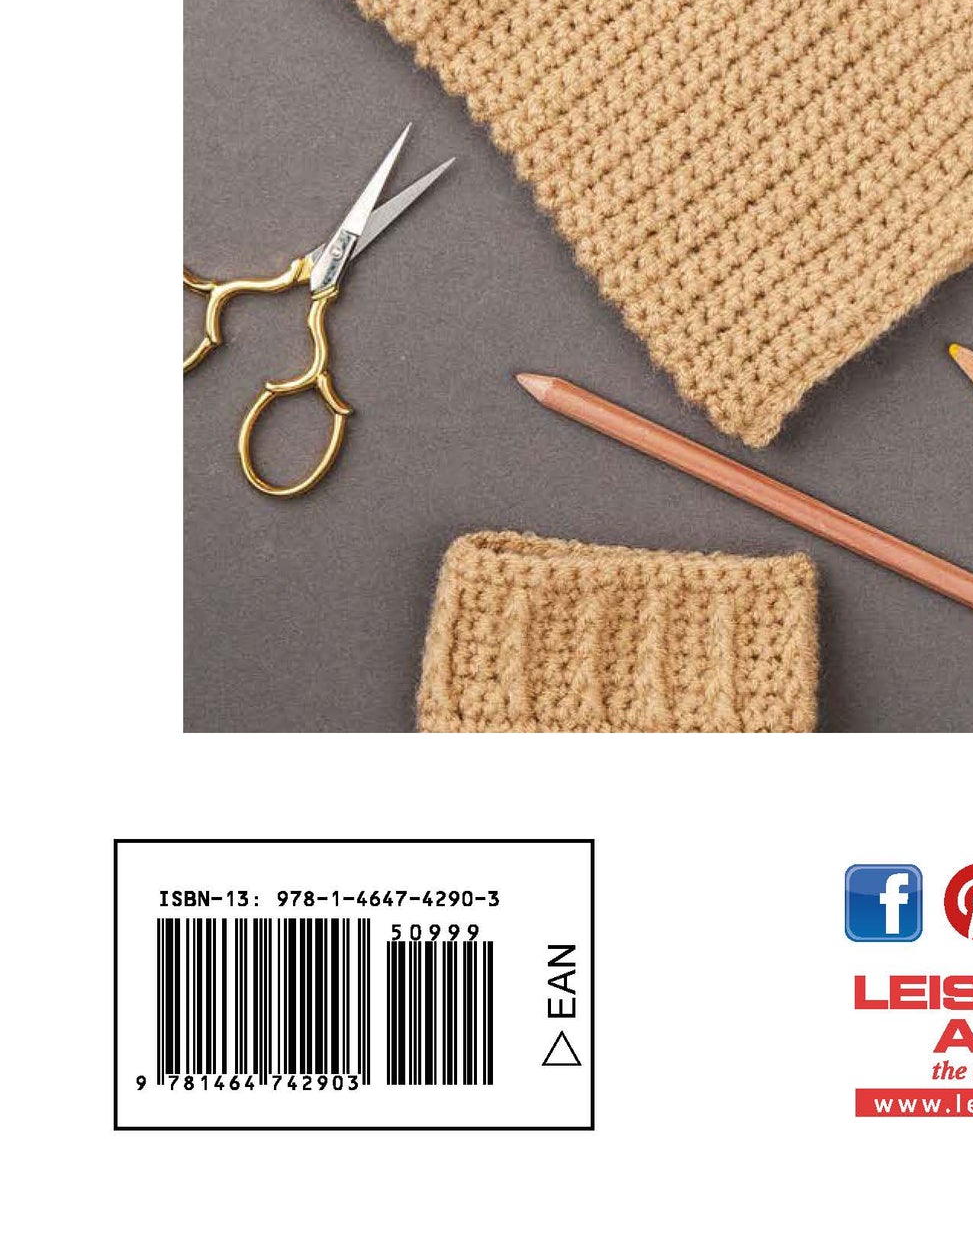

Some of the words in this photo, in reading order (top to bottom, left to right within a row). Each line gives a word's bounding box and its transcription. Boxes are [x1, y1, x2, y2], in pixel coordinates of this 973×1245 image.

[159, 890, 259, 907] ISBN-13:
[277, 890, 500, 907] 978-1-4647-4290-3
[391, 923, 480, 941] 50999
[547, 944, 577, 1019] EAN
[932, 1060, 967, 1081] the
[168, 1075, 256, 1091] 781464
[271, 1075, 359, 1091] 742903
